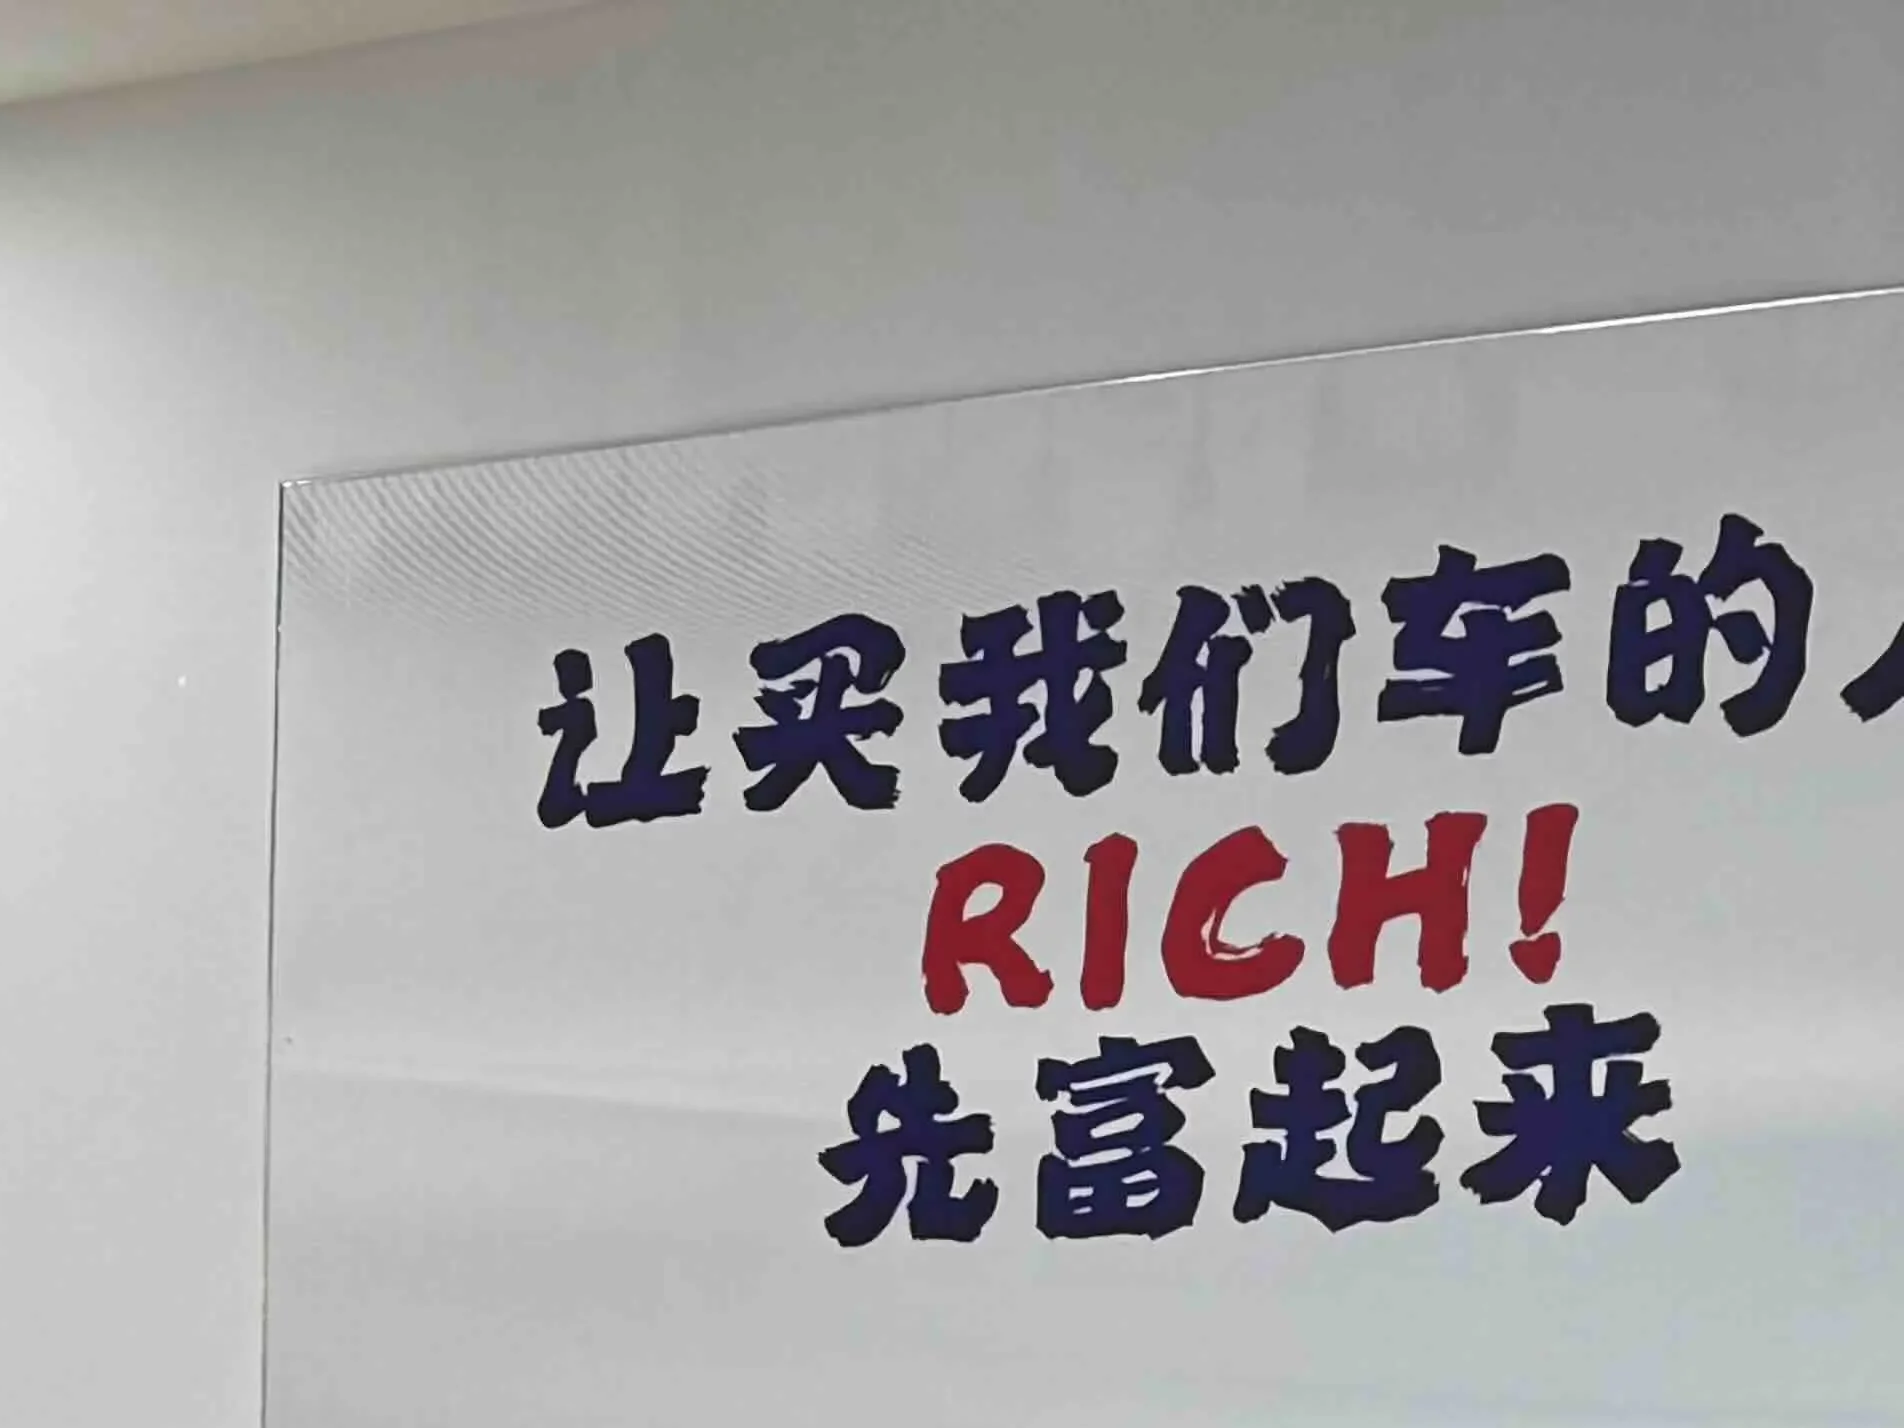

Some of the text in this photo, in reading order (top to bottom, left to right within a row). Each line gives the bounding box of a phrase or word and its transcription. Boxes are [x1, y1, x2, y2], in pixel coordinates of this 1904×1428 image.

[922, 804, 1579, 1014] RICH!
[818, 1002, 1686, 1247] 先富起来
